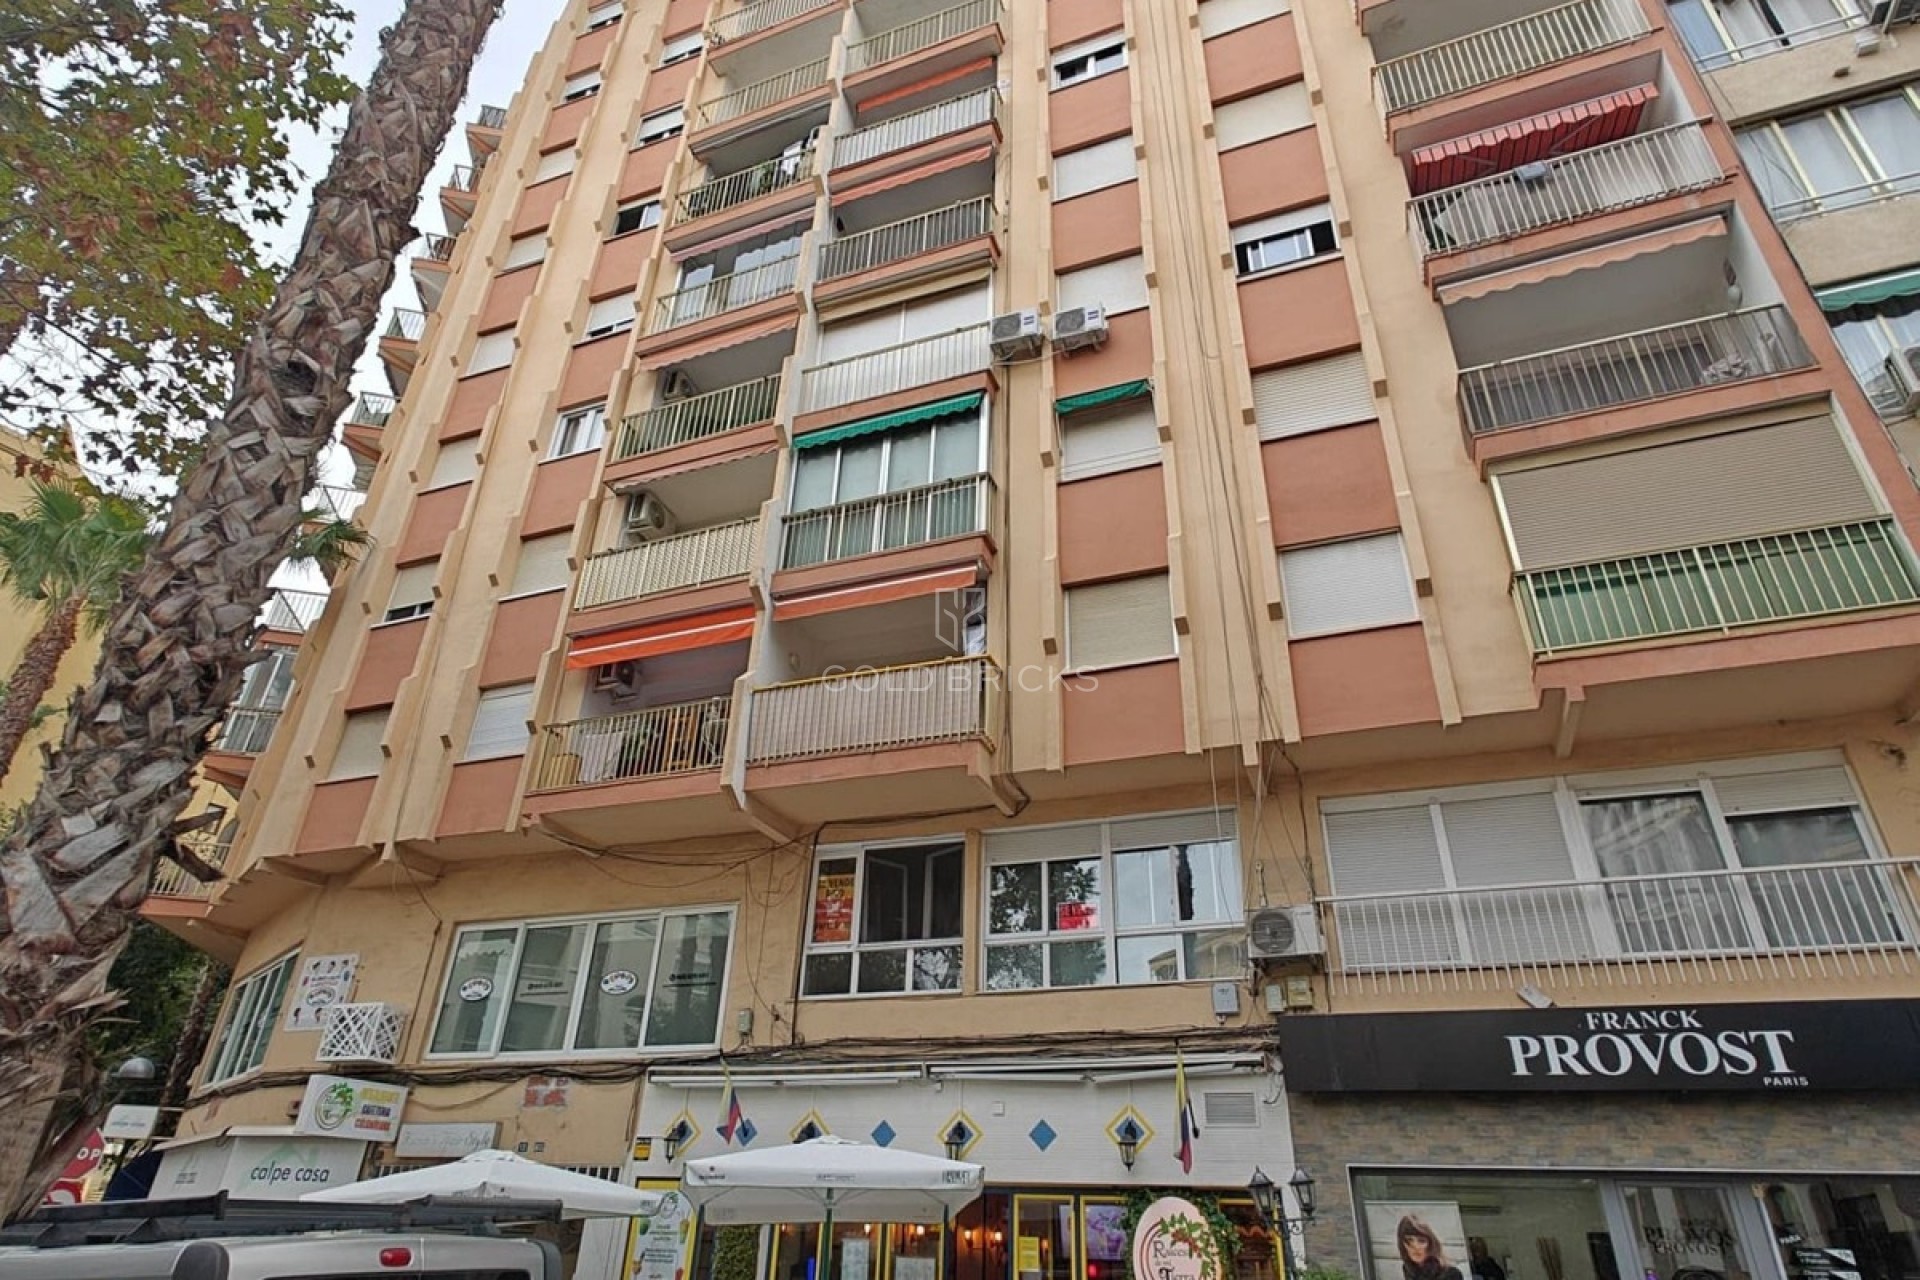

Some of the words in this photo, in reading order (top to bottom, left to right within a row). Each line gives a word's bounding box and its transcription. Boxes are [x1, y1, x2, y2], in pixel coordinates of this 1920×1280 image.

[1585, 1009, 1703, 1030] FRANCK
[1504, 1030, 1795, 1076] PROVOST
[1763, 1076, 1809, 1086] PARIS
[77, 1148, 100, 1160] OP
[250, 1160, 291, 1185] calpe
[295, 1167, 330, 1183] casa
